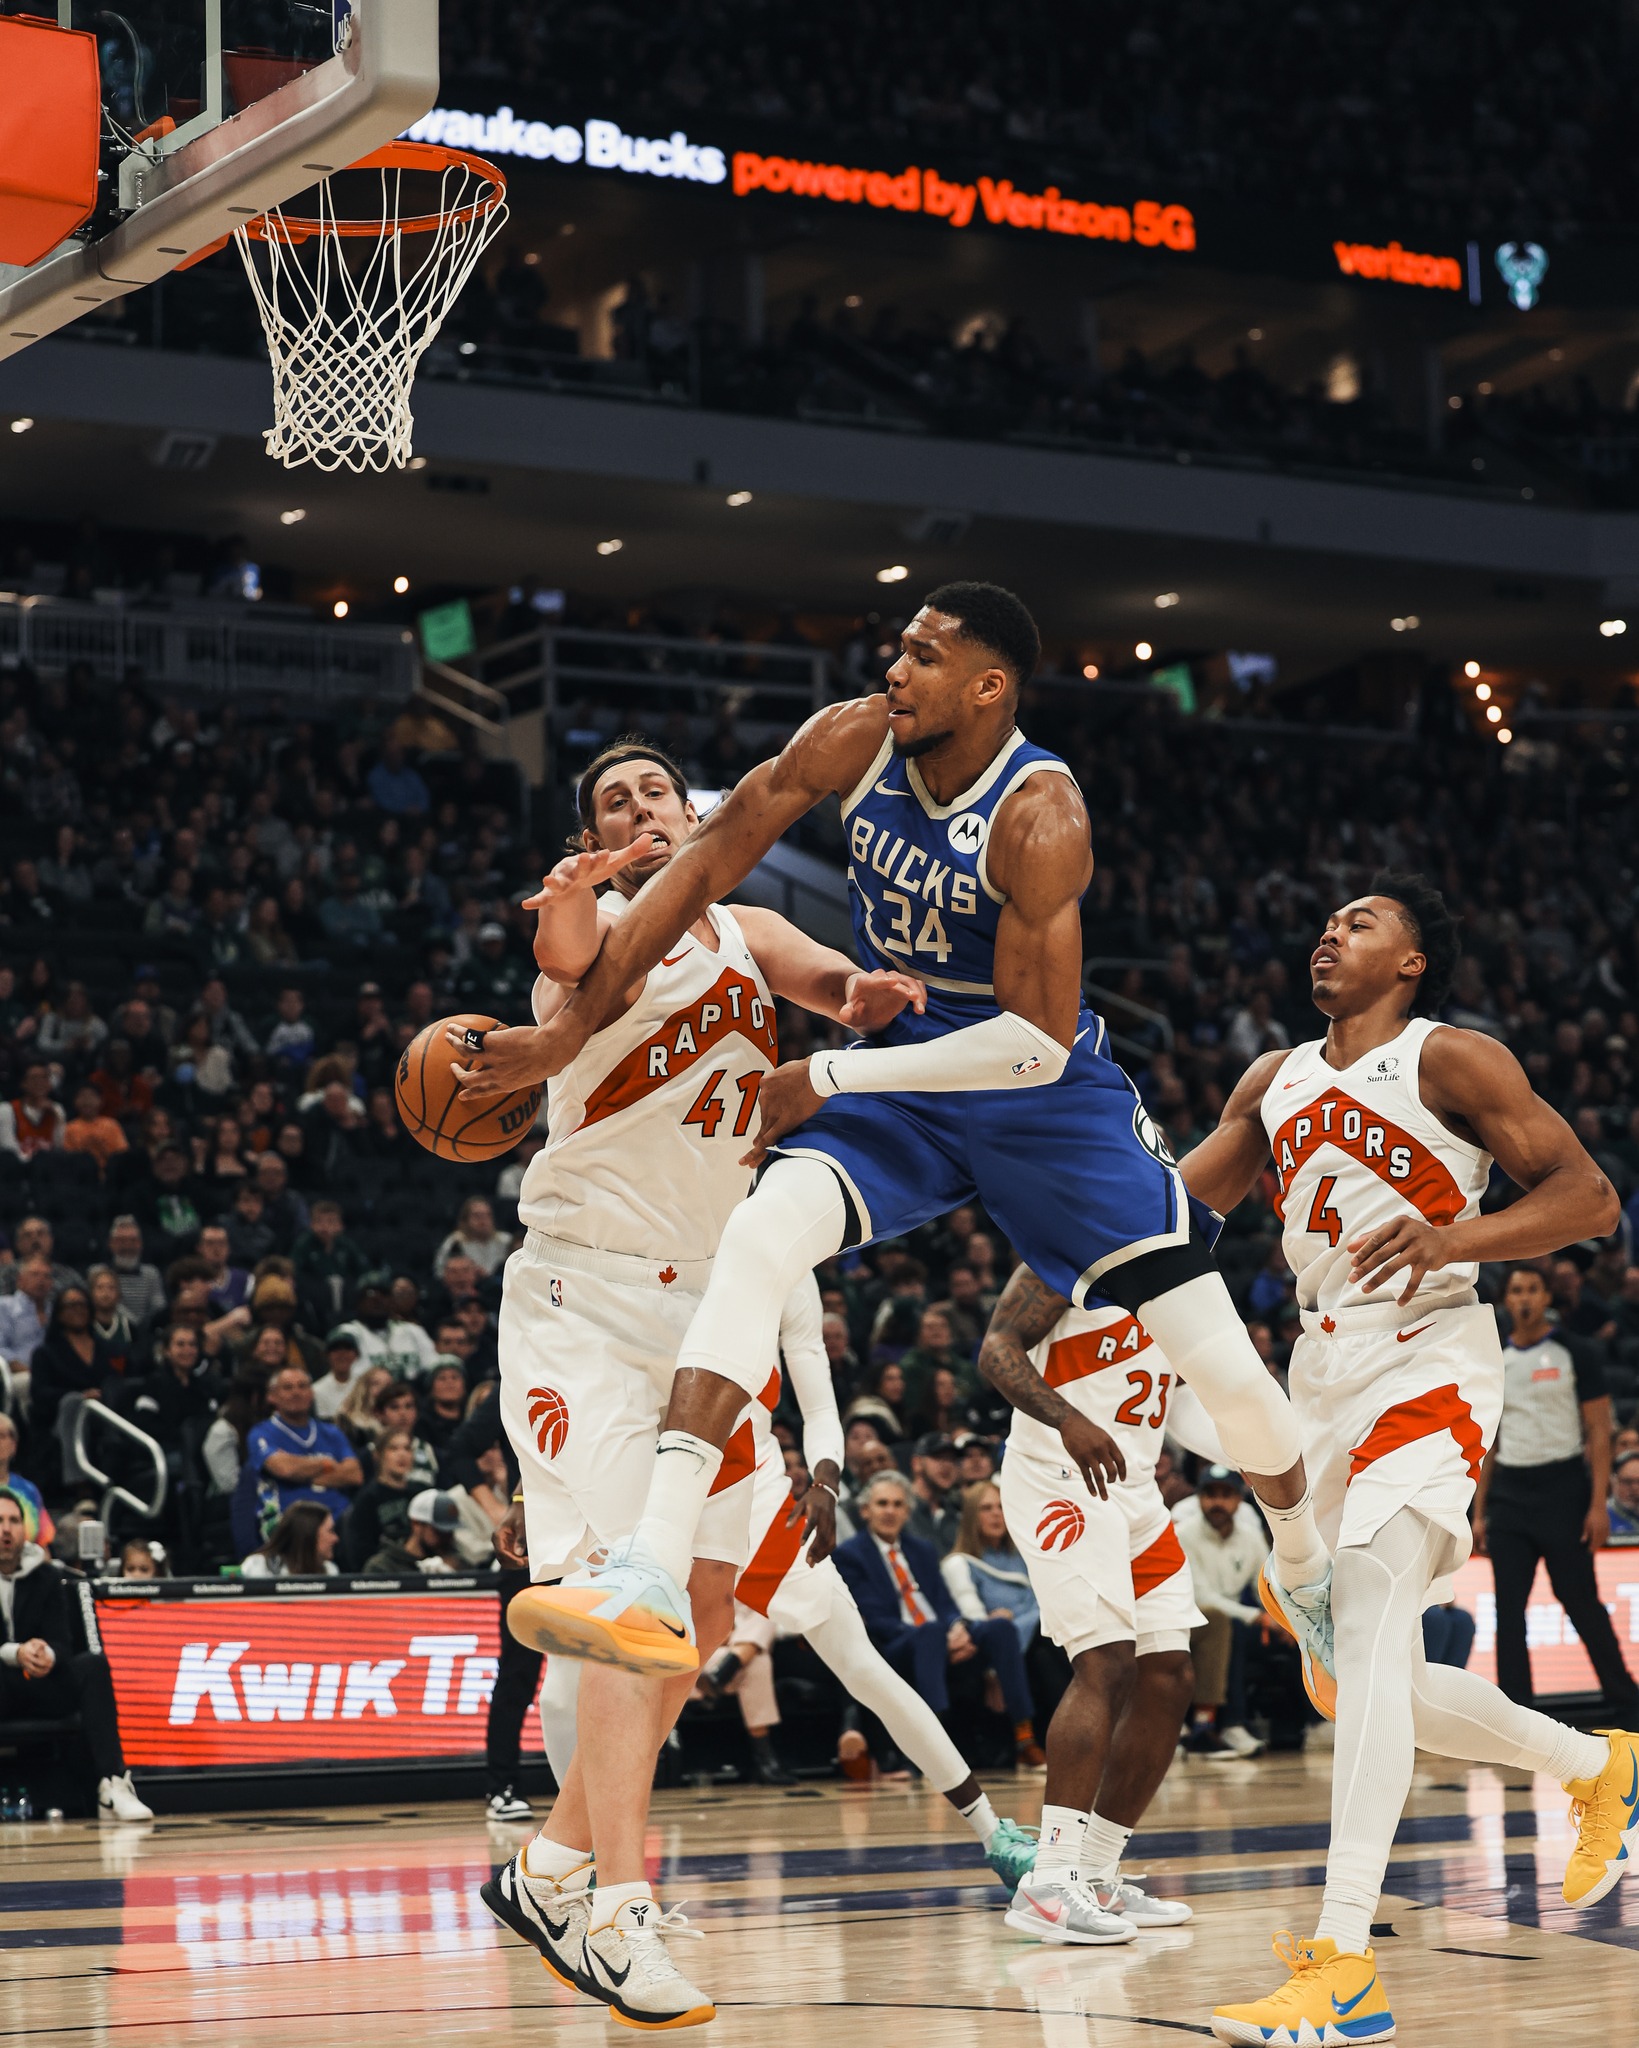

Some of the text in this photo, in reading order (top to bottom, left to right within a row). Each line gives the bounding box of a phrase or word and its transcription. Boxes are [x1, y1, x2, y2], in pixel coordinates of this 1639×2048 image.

[584, 118, 728, 184] Bucks
[733, 152, 922, 211] powered
[923, 169, 977, 226] by
[977, 177, 1132, 241] Verizon
[1133, 201, 1196, 250] 5G
[1333, 241, 1462, 290] verizon
[852, 816, 977, 915] BUCKS
[882, 890, 953, 963] 34
[648, 985, 775, 1078] RAPTO
[681, 1069, 765, 1137] 41
[1366, 1072, 1400, 1083] Sun Life
[1277, 1100, 1412, 1194] RAPTORS
[1306, 1175, 1343, 1248] 4
[1096, 1324, 1148, 1362] RA
[1114, 1369, 1171, 1429] 23
